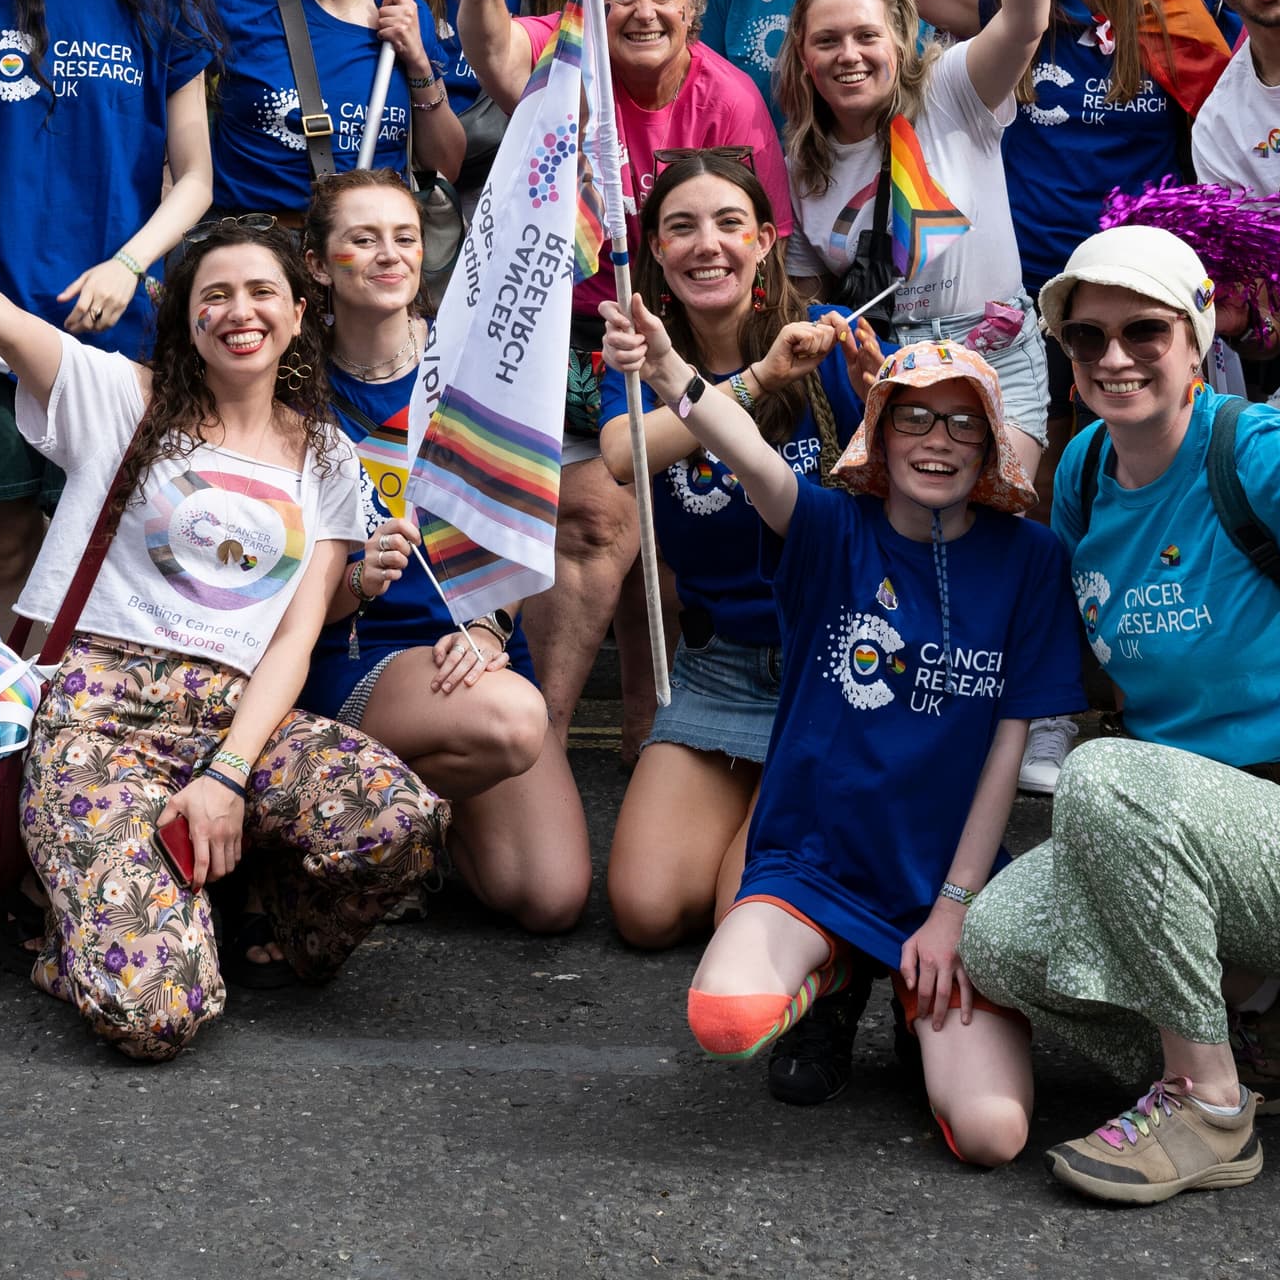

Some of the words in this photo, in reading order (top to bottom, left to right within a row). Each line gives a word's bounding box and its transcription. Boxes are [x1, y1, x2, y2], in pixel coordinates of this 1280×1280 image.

[53, 40, 132, 63] CANCER
[53, 60, 144, 87] RESEARCH
[52, 80, 78, 97] UK
[1085, 78, 1154, 95] CAER
[1081, 110, 1105, 126] UK
[338, 134, 361, 152] UK
[895, 281, 937, 297] cancer
[777, 437, 821, 461] CER
[224, 532, 279, 556] RSEARCH
[227, 524, 272, 544] CANCER
[1124, 583, 1185, 609] CNCER
[127, 595, 183, 625] Beating
[185, 617, 241, 639] cancer
[242, 631, 261, 649] for
[1116, 604, 1213, 634] RESEARCH
[154, 626, 225, 653] everyone
[1118, 639, 1144, 660] UK
[910, 690, 944, 717] UK
